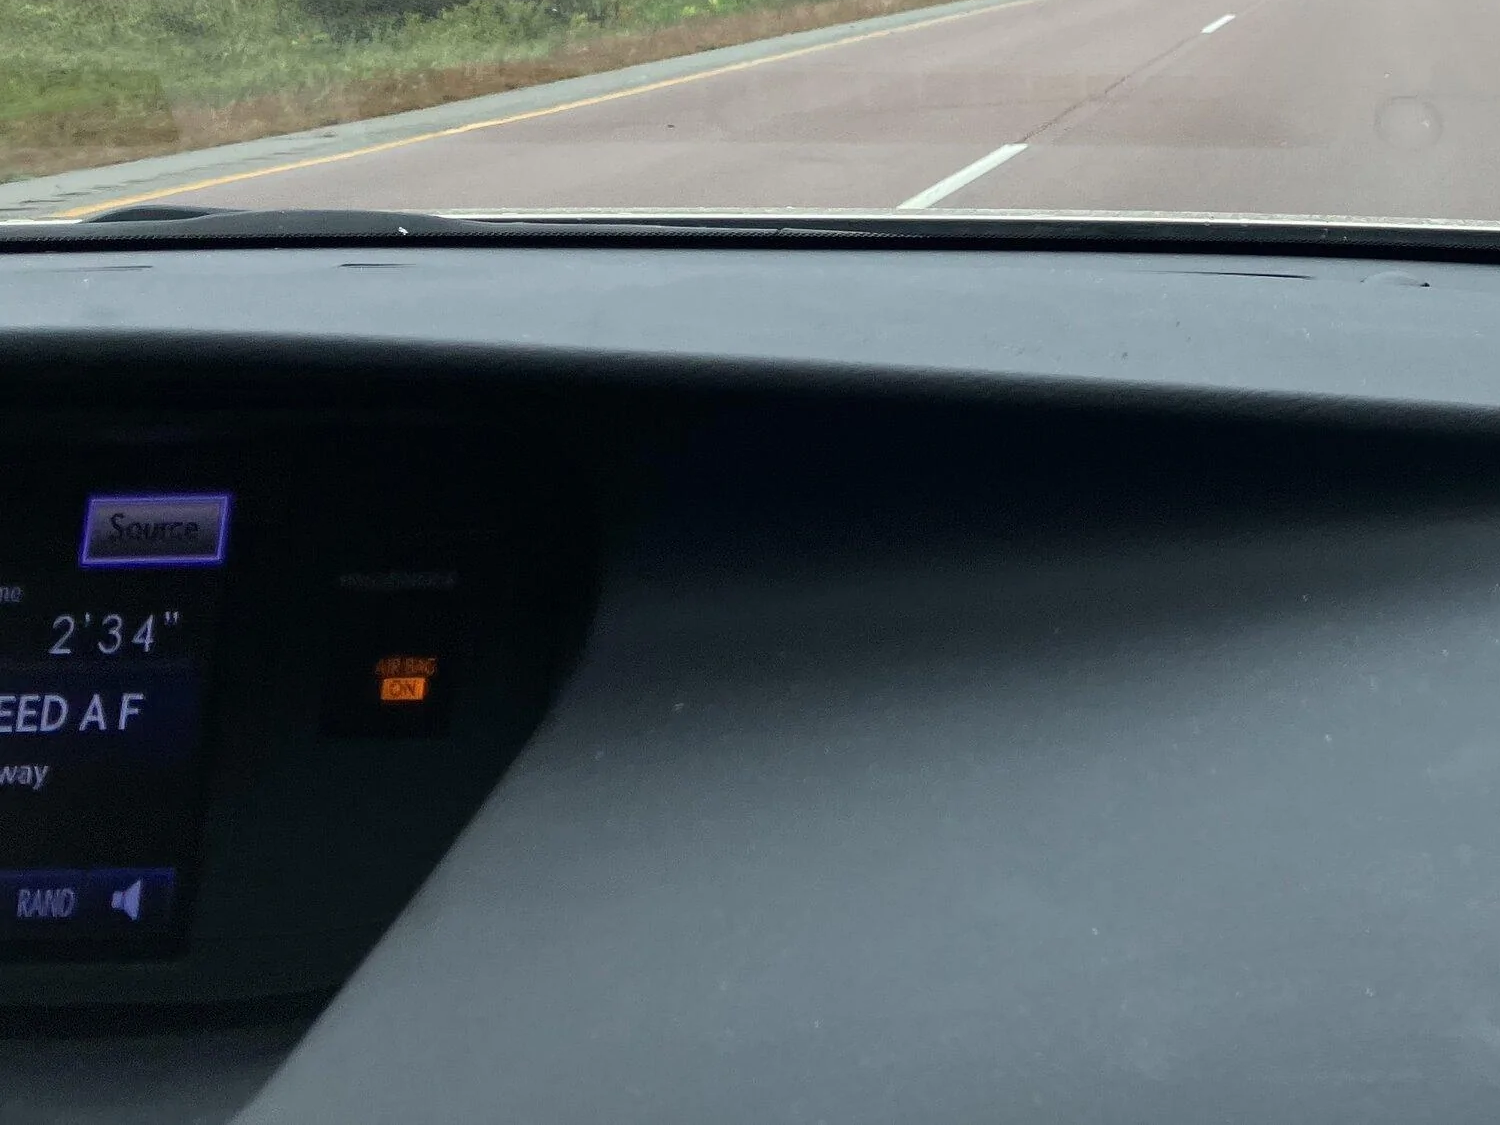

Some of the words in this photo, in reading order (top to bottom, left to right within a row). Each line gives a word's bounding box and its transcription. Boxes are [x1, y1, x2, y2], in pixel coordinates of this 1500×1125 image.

[109, 512, 199, 540] Source
[389, 679, 417, 698] ON
[79, 693, 107, 732] A
[119, 693, 145, 732] F
[0, 765, 49, 790] way
[15, 887, 76, 918] RAND
